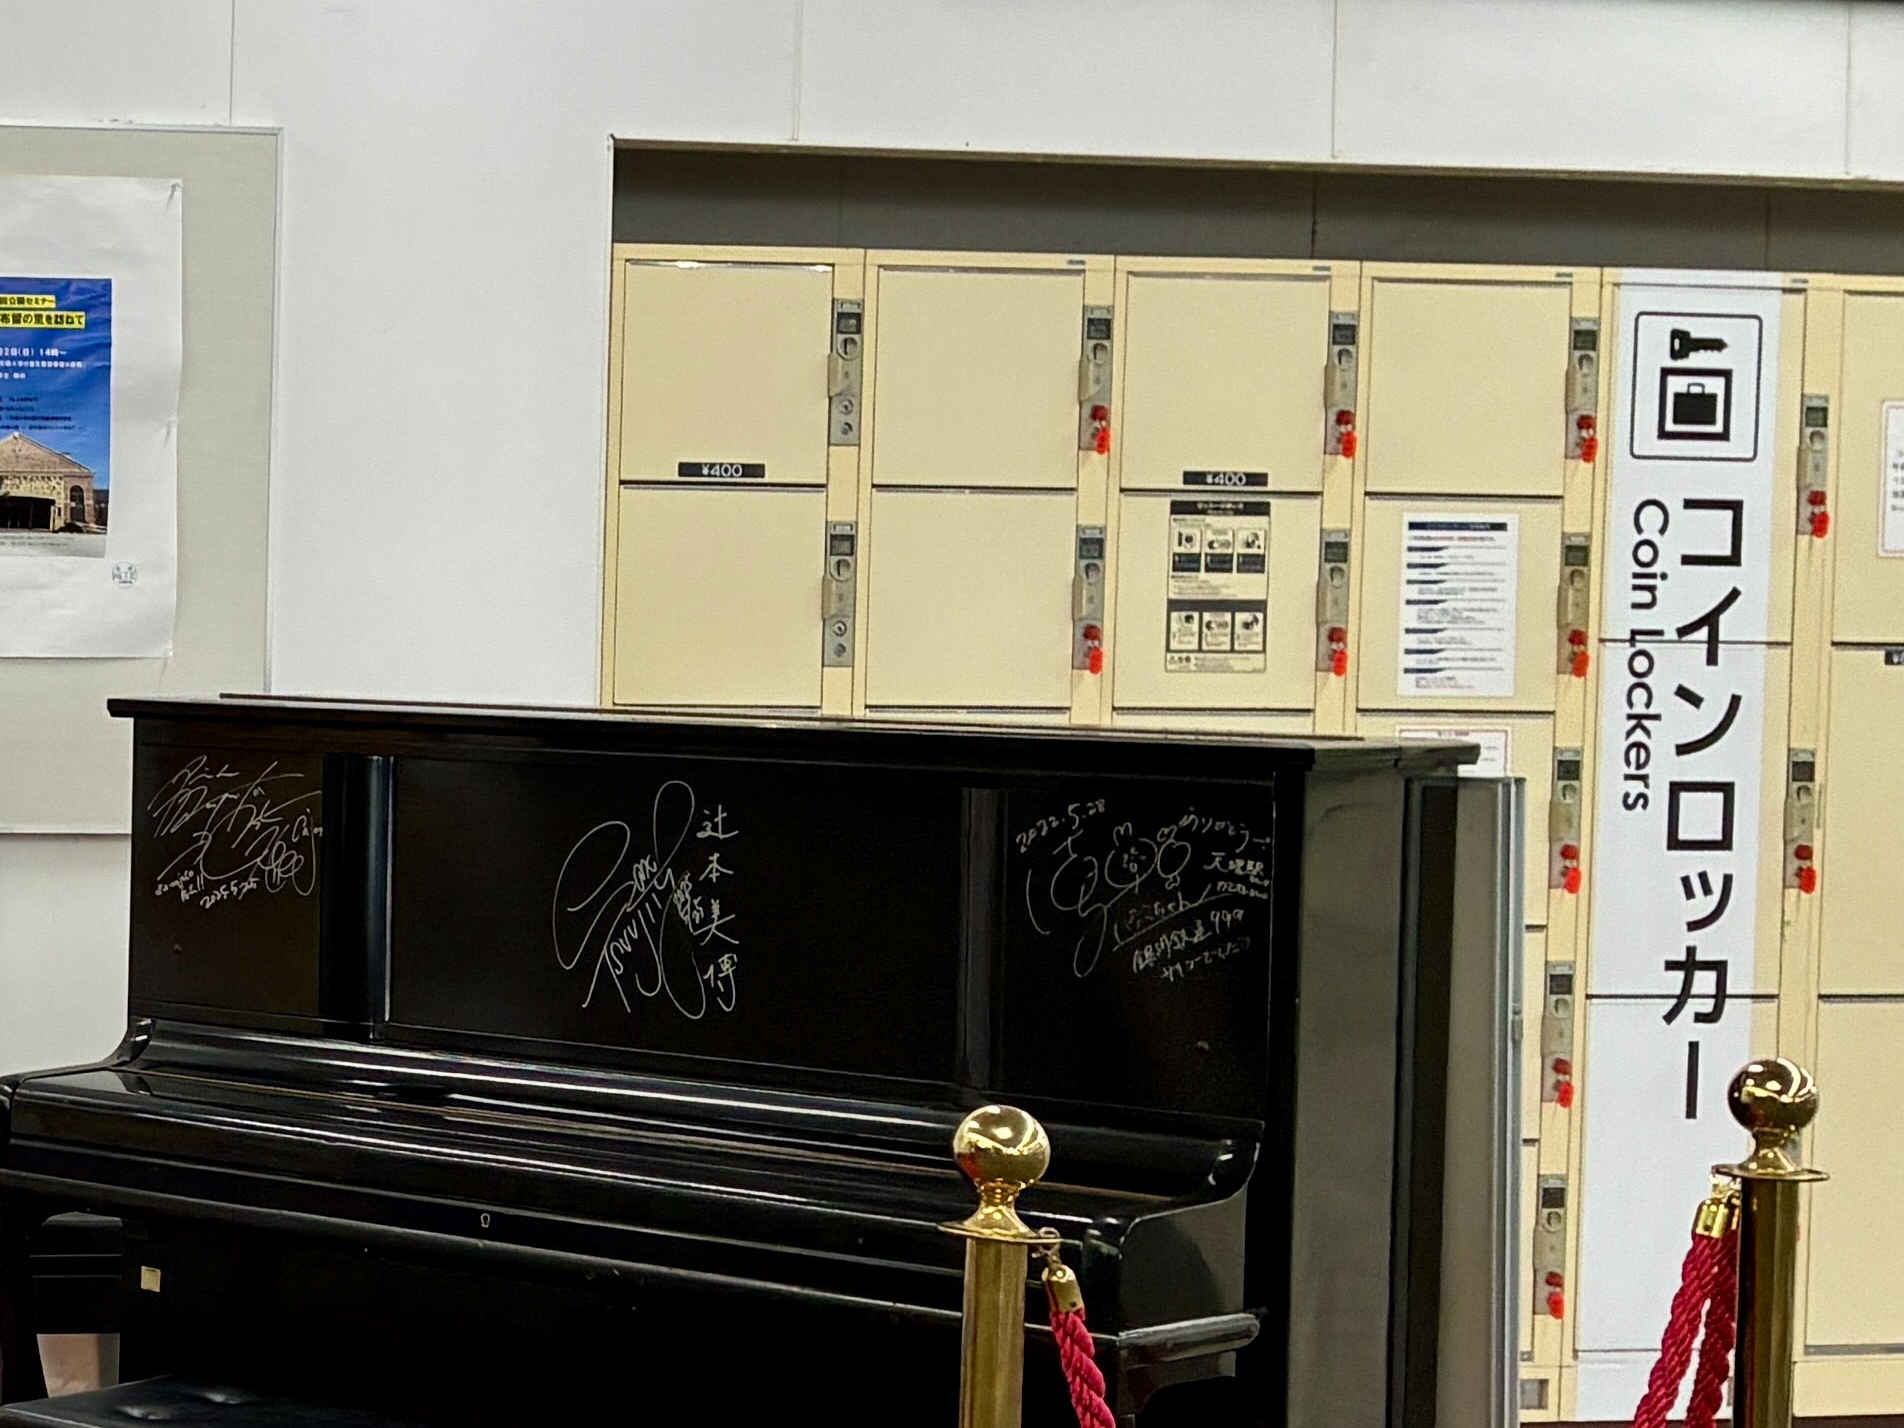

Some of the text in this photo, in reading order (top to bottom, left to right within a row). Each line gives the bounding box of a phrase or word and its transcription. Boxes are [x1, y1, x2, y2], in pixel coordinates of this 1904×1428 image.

[700, 462, 744, 478] ¥400
[1621, 498, 1670, 813] Coin Lockers
[1663, 497, 1744, 1121] コインロッカー
